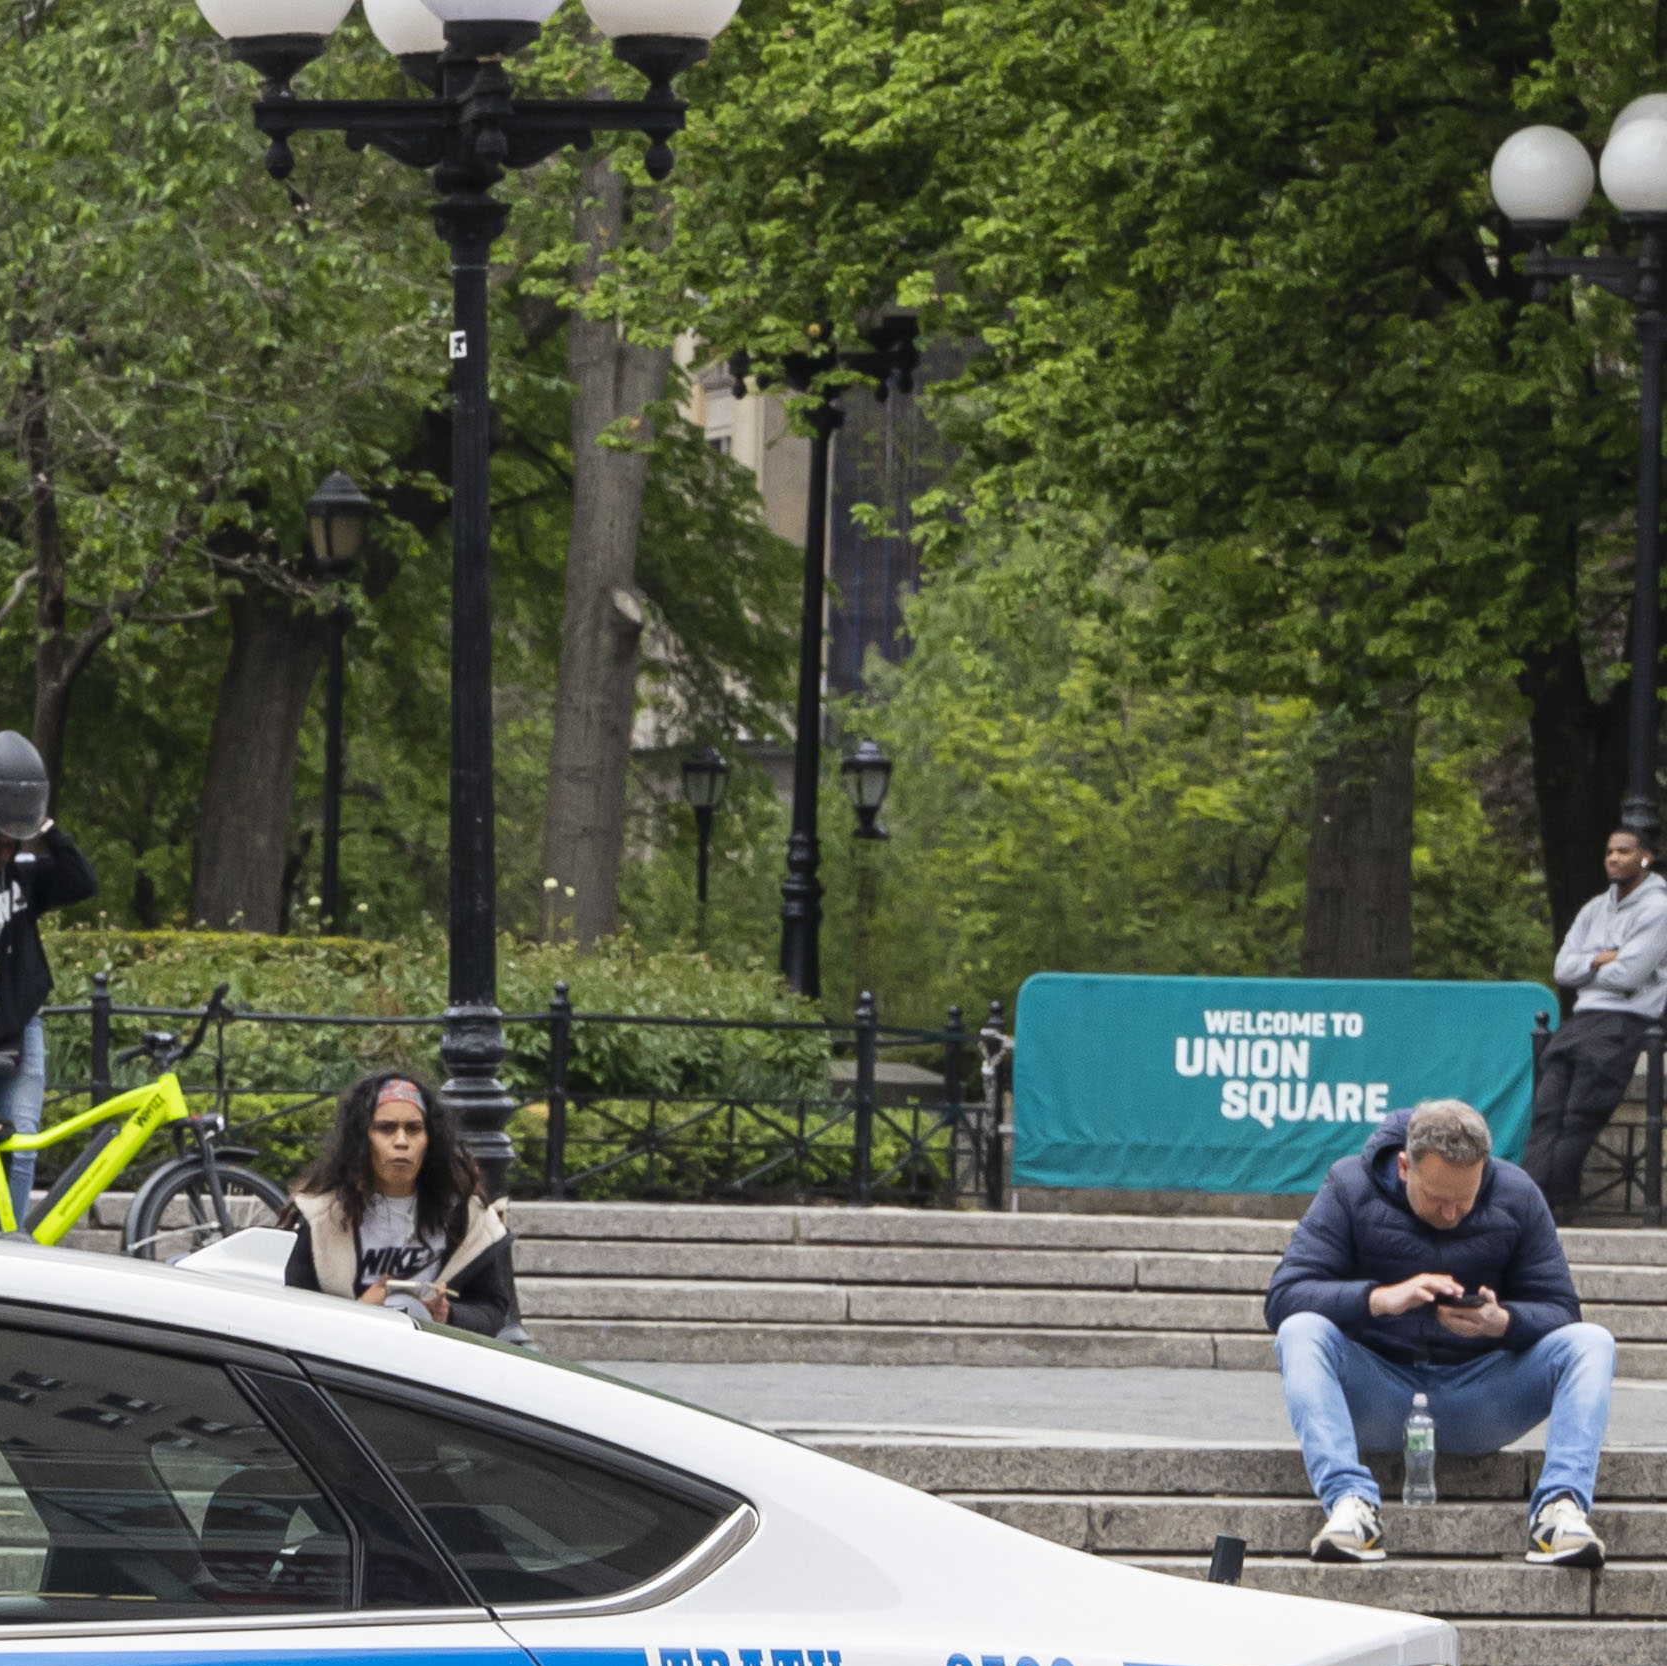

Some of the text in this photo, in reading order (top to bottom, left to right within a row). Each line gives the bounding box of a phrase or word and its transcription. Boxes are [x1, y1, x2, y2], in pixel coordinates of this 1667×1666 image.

[1204, 1010, 1363, 1038] WELCOME TO
[1174, 1037, 1309, 1079] UNION
[1220, 1081, 1389, 1129] SQUARE
[362, 1246, 430, 1280] NIKE
